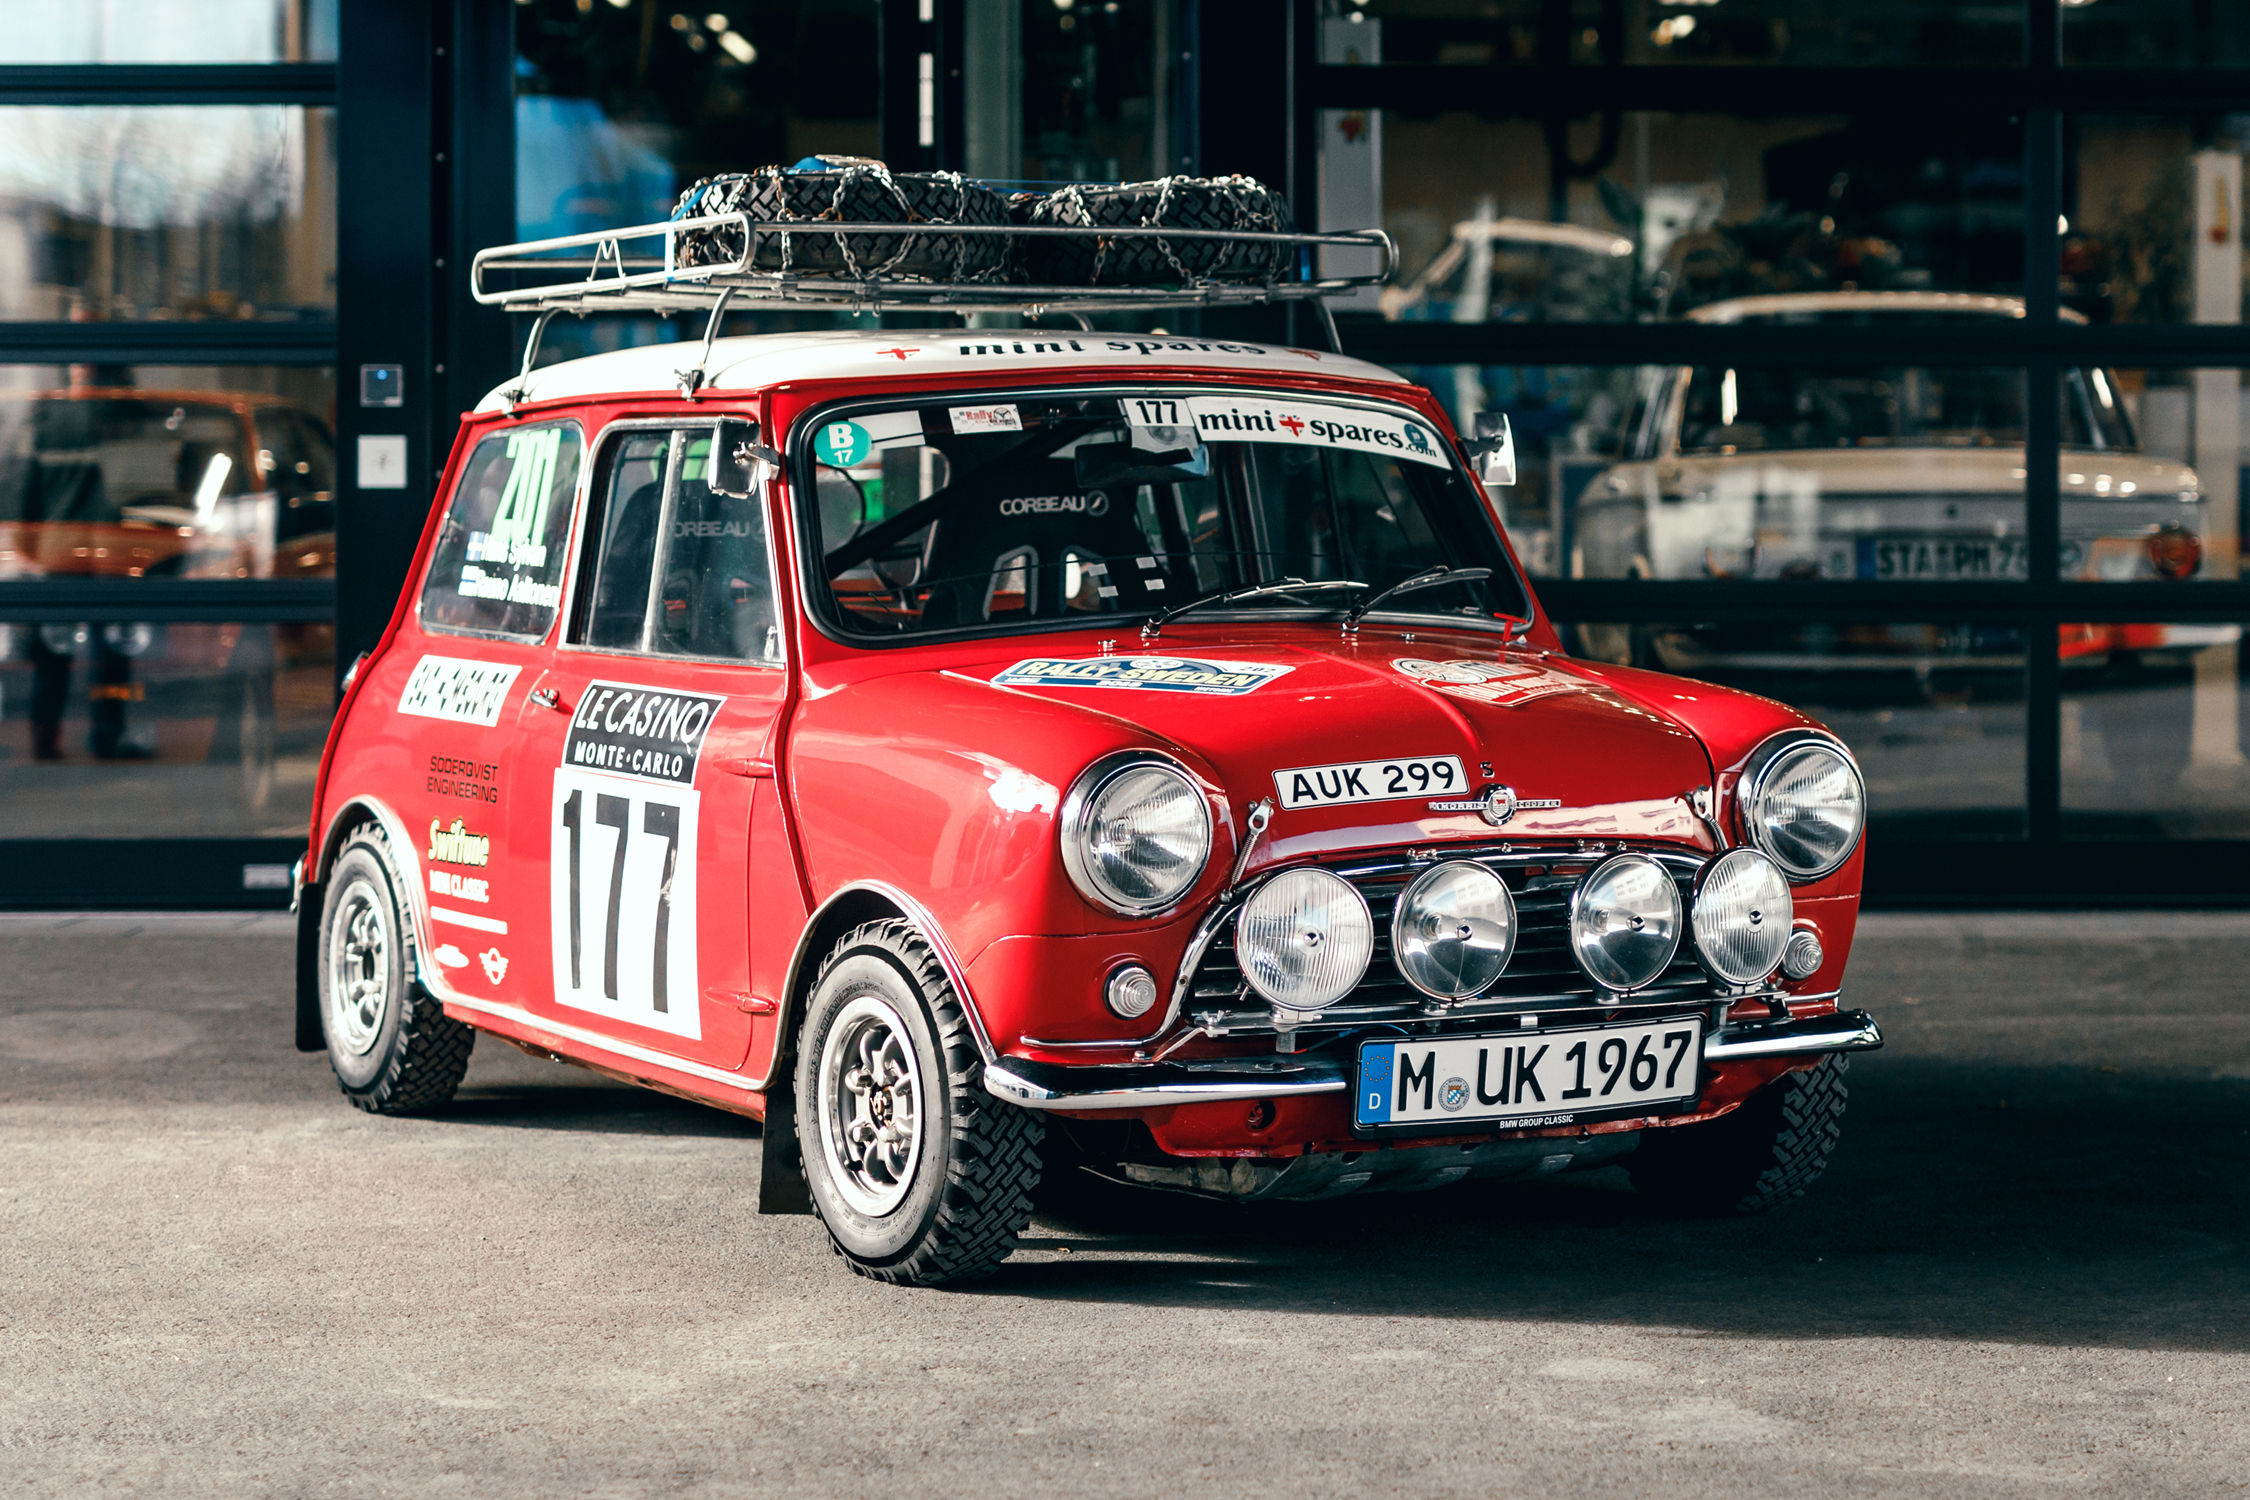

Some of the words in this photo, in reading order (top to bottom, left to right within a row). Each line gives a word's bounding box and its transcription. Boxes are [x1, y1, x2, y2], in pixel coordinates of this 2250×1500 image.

[959, 340, 1087, 356] mini
[1106, 341, 1267, 356] spares
[965, 410, 993, 422] Rally
[1135, 400, 1179, 425] 177
[1199, 408, 1277, 433] mini
[828, 423, 854, 450] B
[834, 450, 854, 464] 17
[999, 496, 1086, 516] CORBEAU
[666, 520, 751, 538] ORBEAU
[1016, 661, 1120, 679] RALLY
[1118, 668, 1261, 687] SWEDEN
[575, 688, 614, 730] LE
[604, 692, 709, 744] CASINO
[1292, 767, 1370, 802] AUK
[1382, 761, 1454, 793] 299
[1480, 761, 1495, 778] S
[427, 776, 499, 804] ENGINEERING
[428, 817, 490, 867] Swiftune
[562, 789, 681, 1015] 177
[1368, 1093, 1381, 1110] D
[1398, 1050, 1436, 1112] M
[1476, 1044, 1550, 1106] UK
[1561, 1030, 1693, 1100] 1967
[1500, 1120, 1519, 1129] BMW
[1518, 1118, 1544, 1127] GROUP
[1543, 1115, 1574, 1125] CLASSIC
